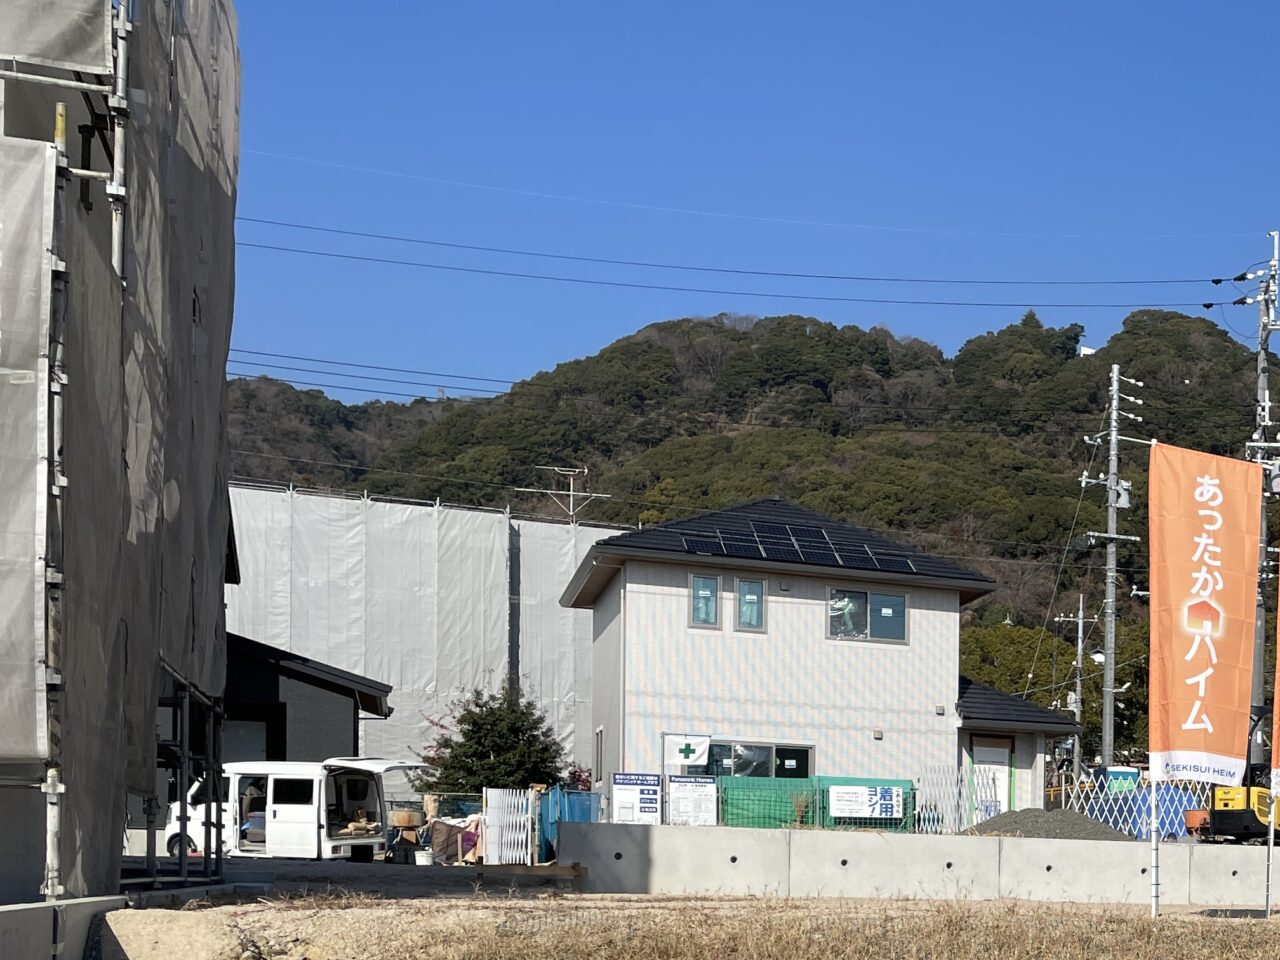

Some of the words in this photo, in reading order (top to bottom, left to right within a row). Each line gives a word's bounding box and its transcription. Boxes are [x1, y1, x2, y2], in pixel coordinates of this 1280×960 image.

[1171, 764, 1211, 775] SEKISUI
[1212, 767, 1236, 778] HEIM
[879, 786, 894, 817] 着用
